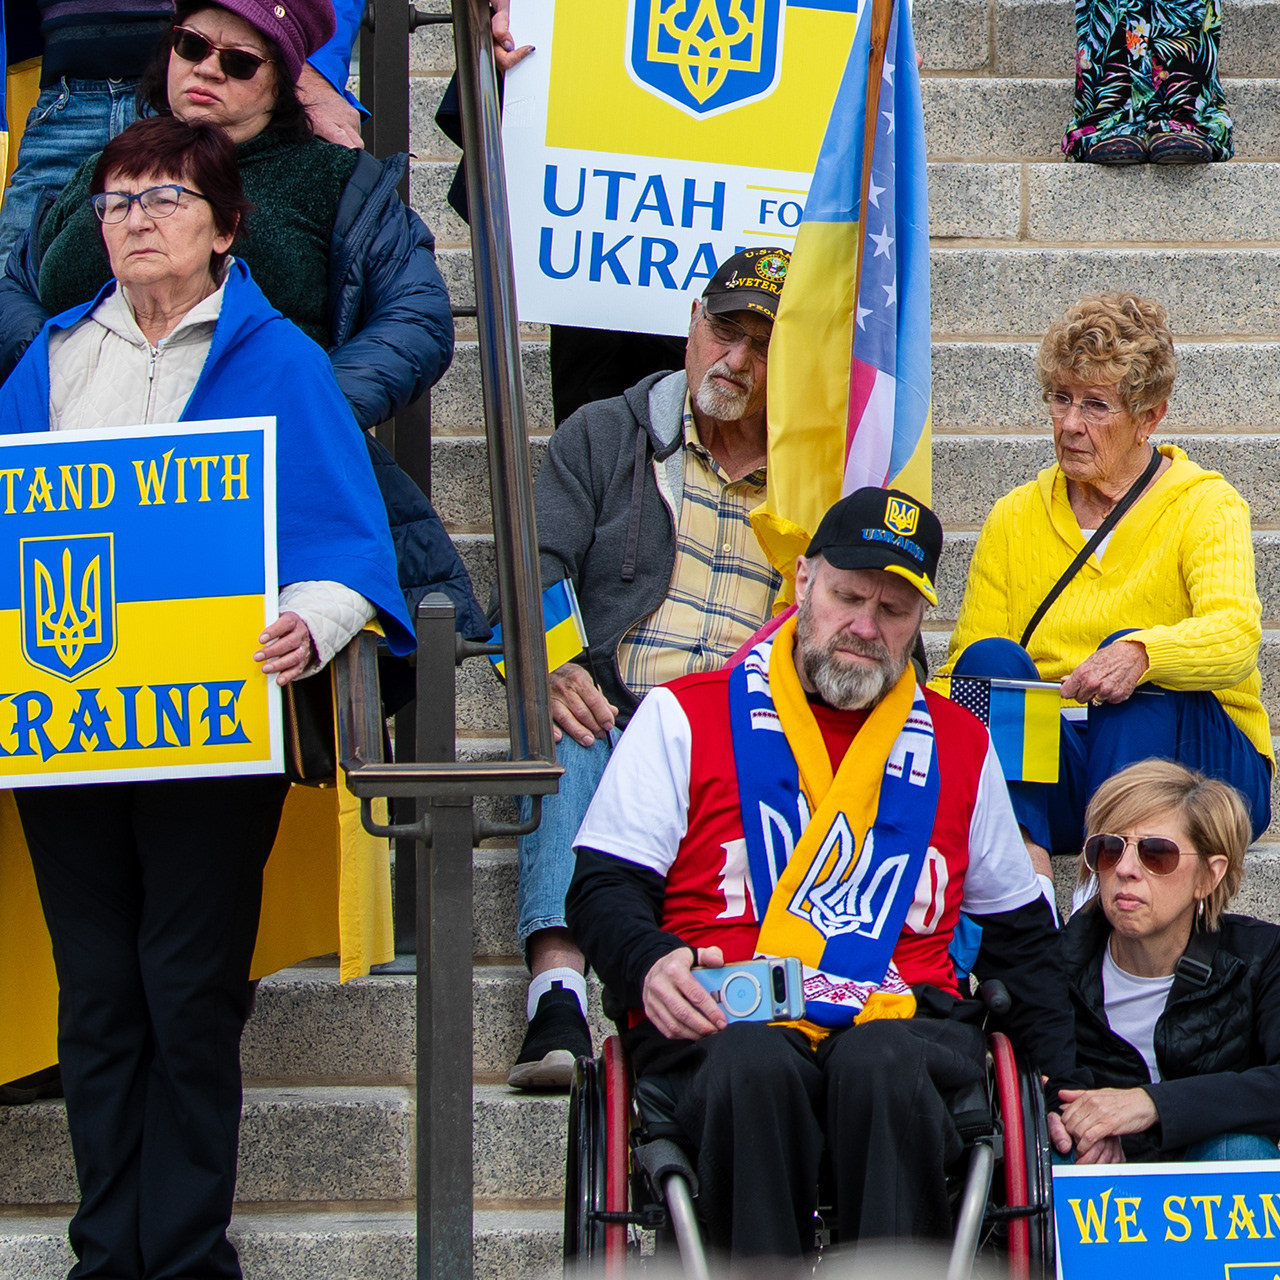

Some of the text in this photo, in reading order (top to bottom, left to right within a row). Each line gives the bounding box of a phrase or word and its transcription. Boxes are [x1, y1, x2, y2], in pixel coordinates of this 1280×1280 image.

[543, 163, 805, 232] UTAH FO
[538, 226, 746, 292] UKRA
[738, 277, 783, 296] VETERA
[747, 302, 777, 321] PROU
[0, 446, 251, 516] TAND WITH
[862, 527, 926, 563] UKRAINE
[0, 678, 253, 764] RAINE
[1067, 1185, 1149, 1245] WE
